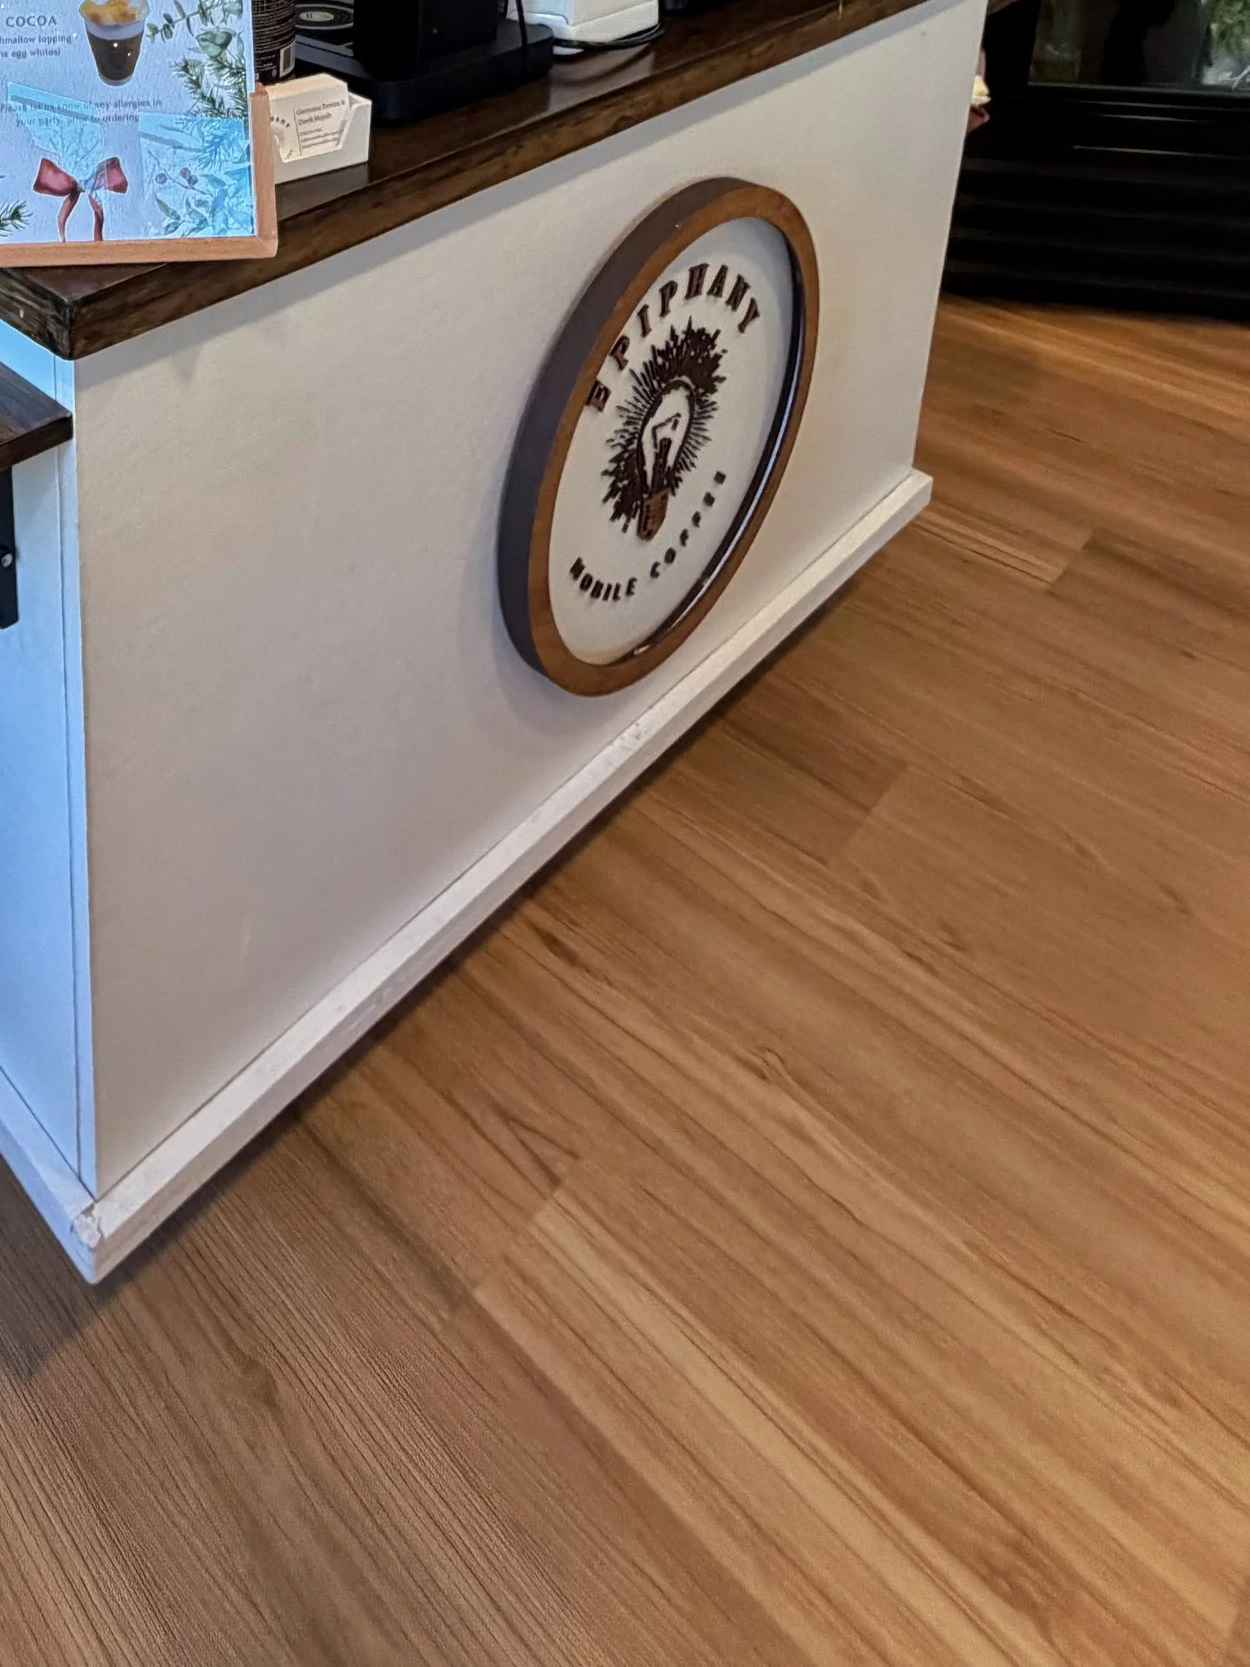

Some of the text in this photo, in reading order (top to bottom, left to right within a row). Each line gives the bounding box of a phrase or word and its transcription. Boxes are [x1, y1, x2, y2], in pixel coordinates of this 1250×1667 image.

[5, 15, 57, 28] COCOA
[38, 34, 72, 45] topping
[11, 50, 27, 60] egg
[29, 47, 62, 57] whites)
[585, 262, 761, 413] EPIPHANY
[569, 470, 727, 602] MOBILE COFFEE
